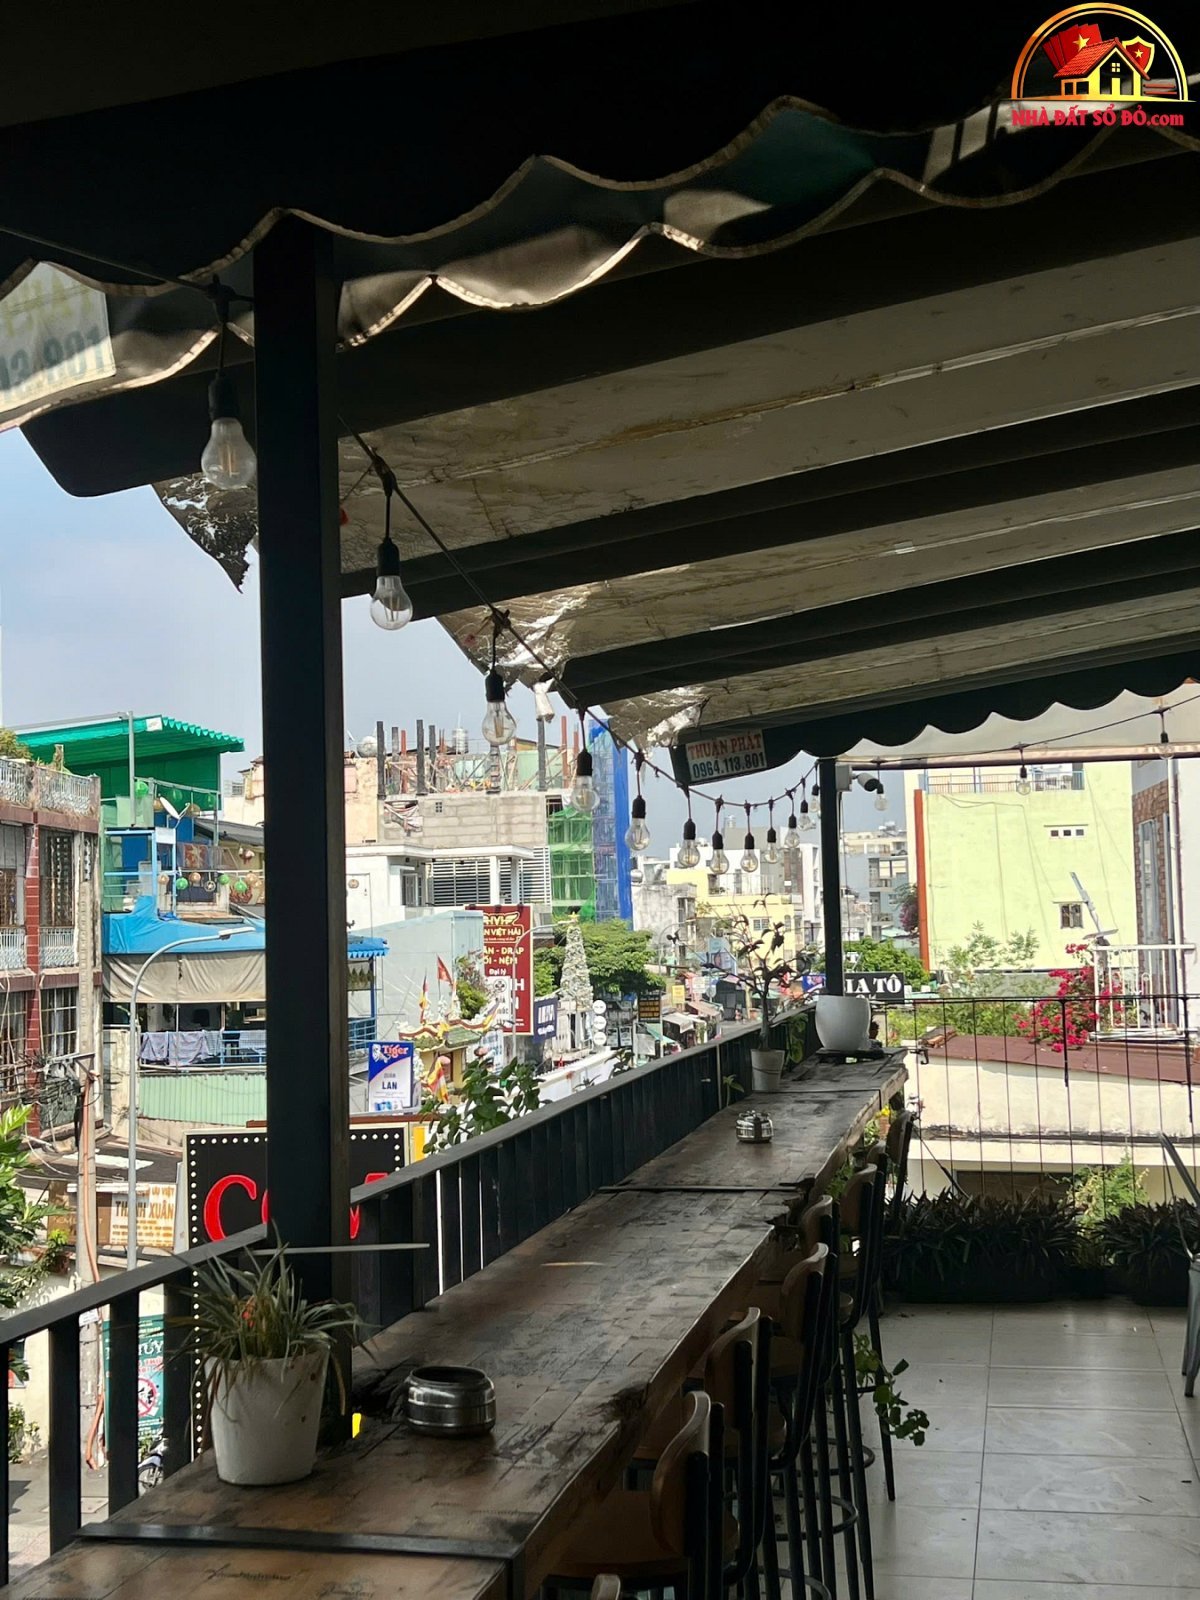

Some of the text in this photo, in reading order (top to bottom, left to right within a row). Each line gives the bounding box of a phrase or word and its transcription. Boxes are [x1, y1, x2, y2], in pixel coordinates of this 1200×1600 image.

[730, 731, 761, 754] PHÁT
[692, 752, 765, 779] 0964.113.801
[845, 973, 902, 993] IA TÔ
[382, 1044, 409, 1058] Tiger
[382, 1081, 397, 1090] LAN
[149, 1199, 174, 1219] XUÂN
